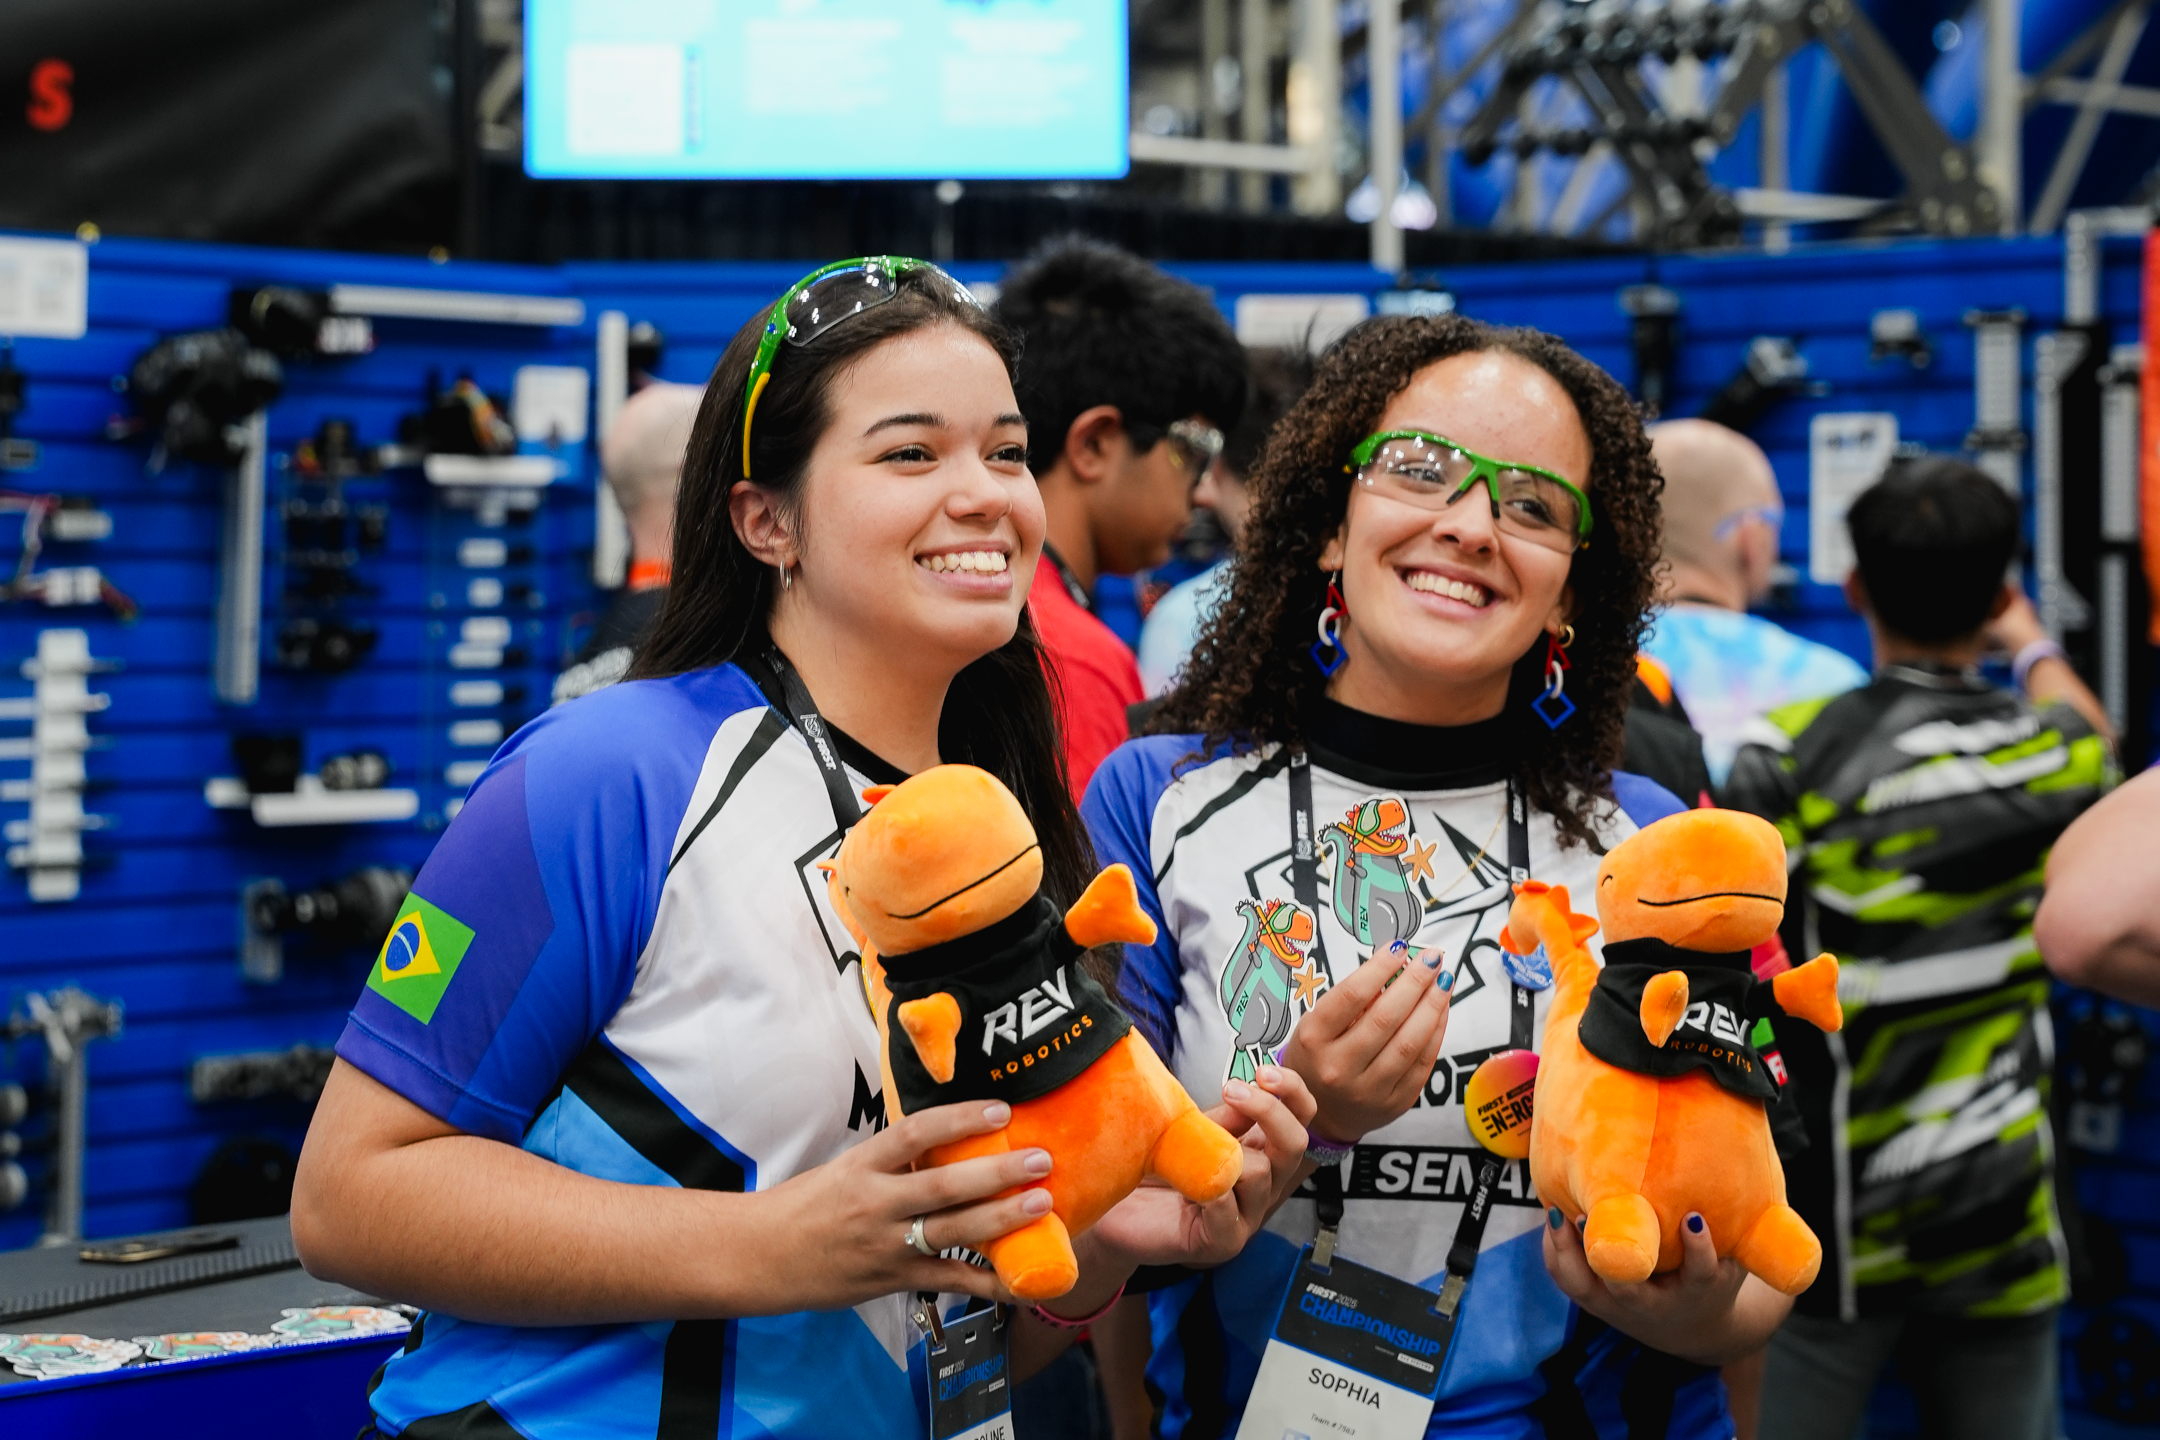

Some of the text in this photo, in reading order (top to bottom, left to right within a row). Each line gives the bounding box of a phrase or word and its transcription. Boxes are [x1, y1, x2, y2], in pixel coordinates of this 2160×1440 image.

[814, 737, 837, 771] FIRST
[1359, 905, 1368, 932] REV
[981, 964, 1075, 1057] REV
[1236, 990, 1249, 1017] REV
[1674, 1000, 1751, 1047] REV
[990, 1014, 1093, 1081] ROBOTICS
[1477, 1095, 1504, 1117] FIRST
[1481, 1091, 1535, 1139] ENERG
[1470, 1185, 1489, 1221] FIRST
[1306, 1282, 1338, 1300] FIRST
[1300, 1292, 1441, 1357] CHAMPIONSHIP
[939, 1363, 955, 1379] FIRST
[939, 1354, 1004, 1401] CHAMPIONSHIP
[1308, 1367, 1380, 1409] SOPHIA
